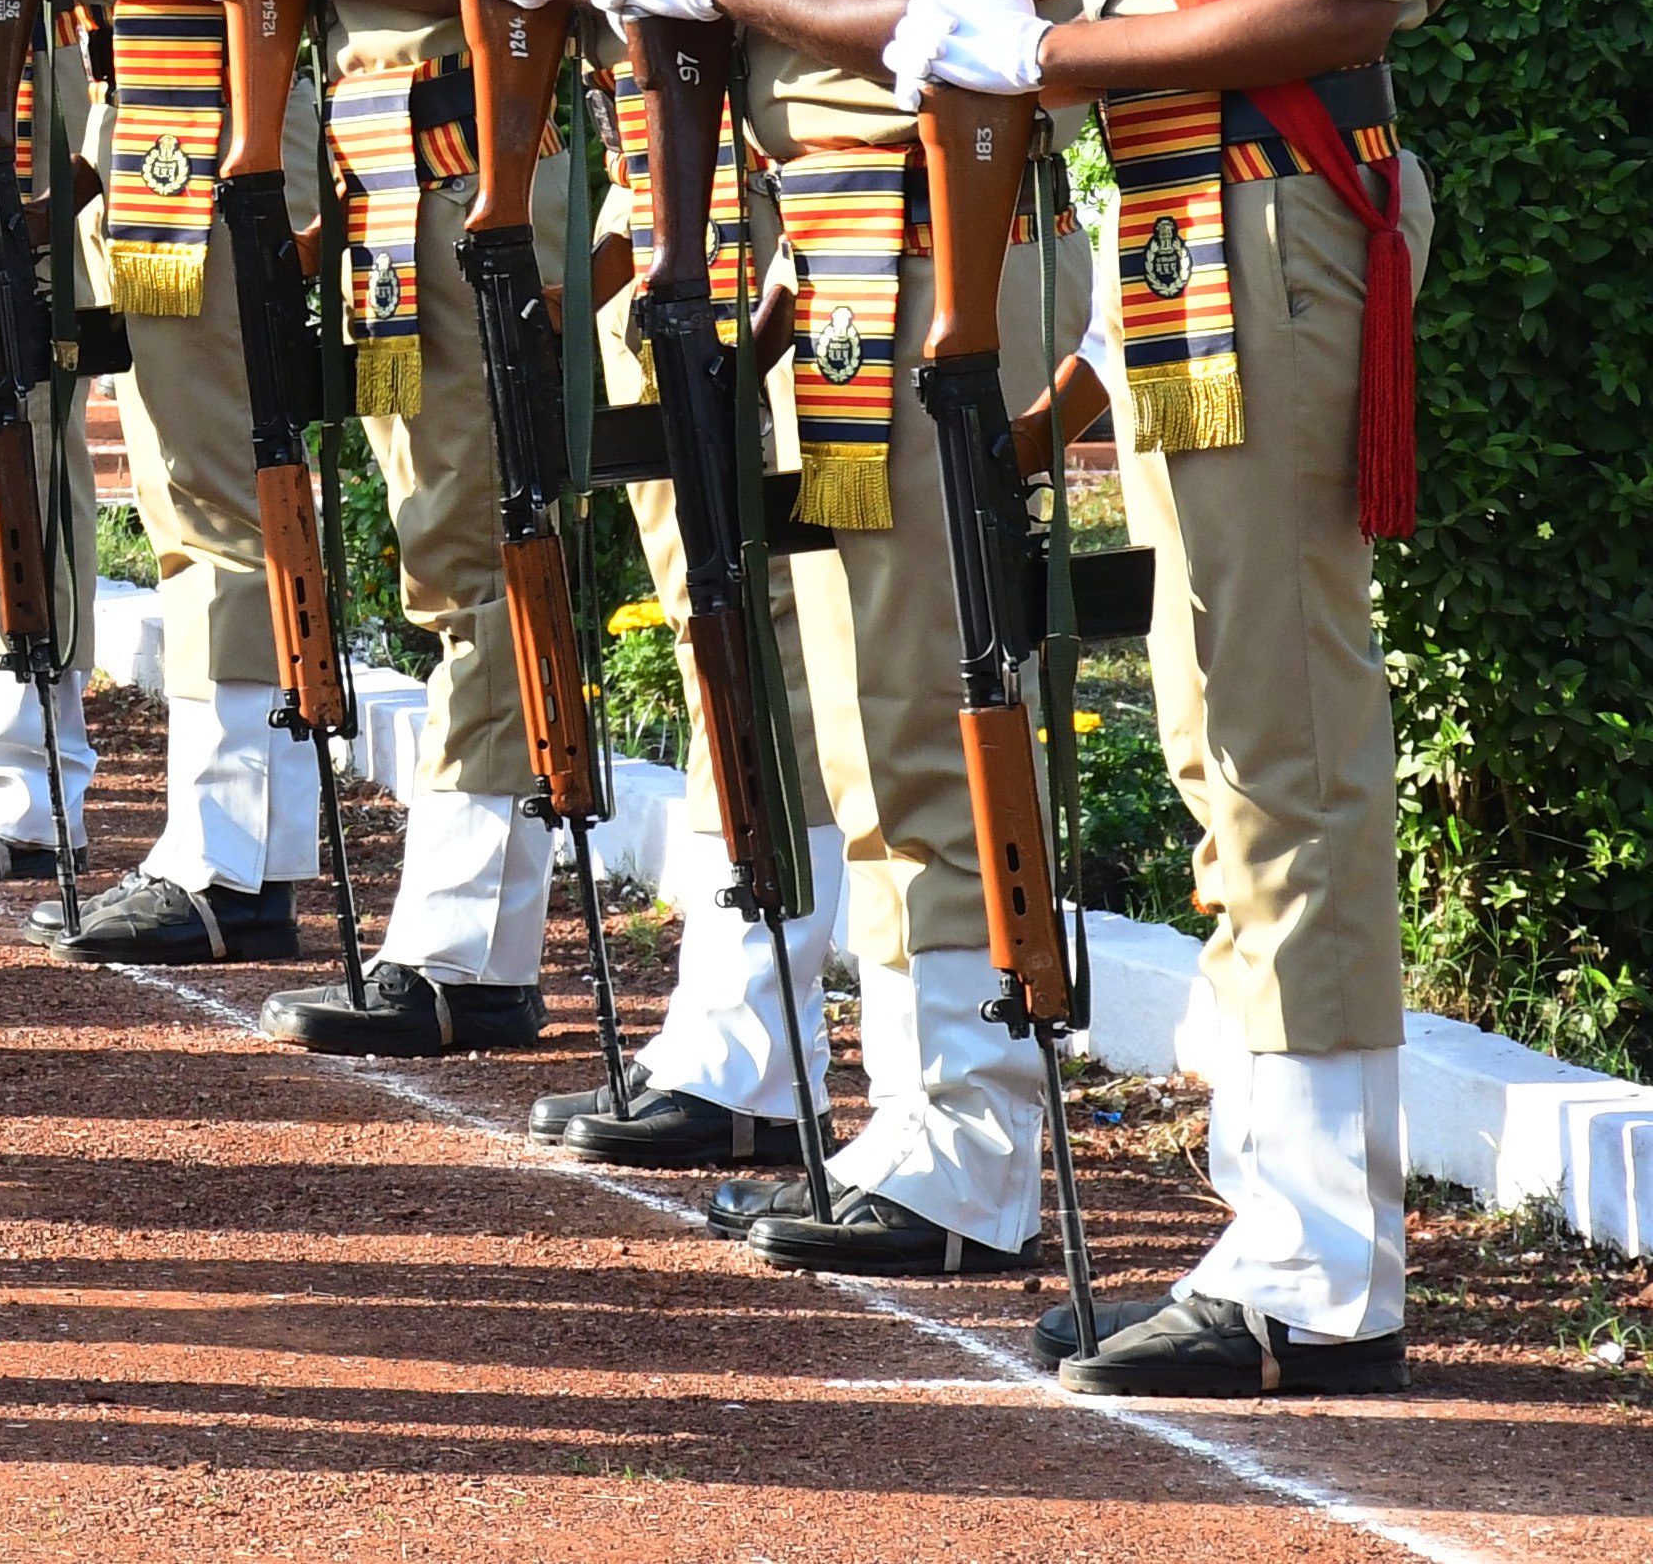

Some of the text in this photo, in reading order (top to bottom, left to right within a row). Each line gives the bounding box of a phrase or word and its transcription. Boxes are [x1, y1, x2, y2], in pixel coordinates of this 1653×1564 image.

[509, 16, 529, 58] 1264
[677, 51, 700, 85] 97
[975, 126, 993, 162] 183
